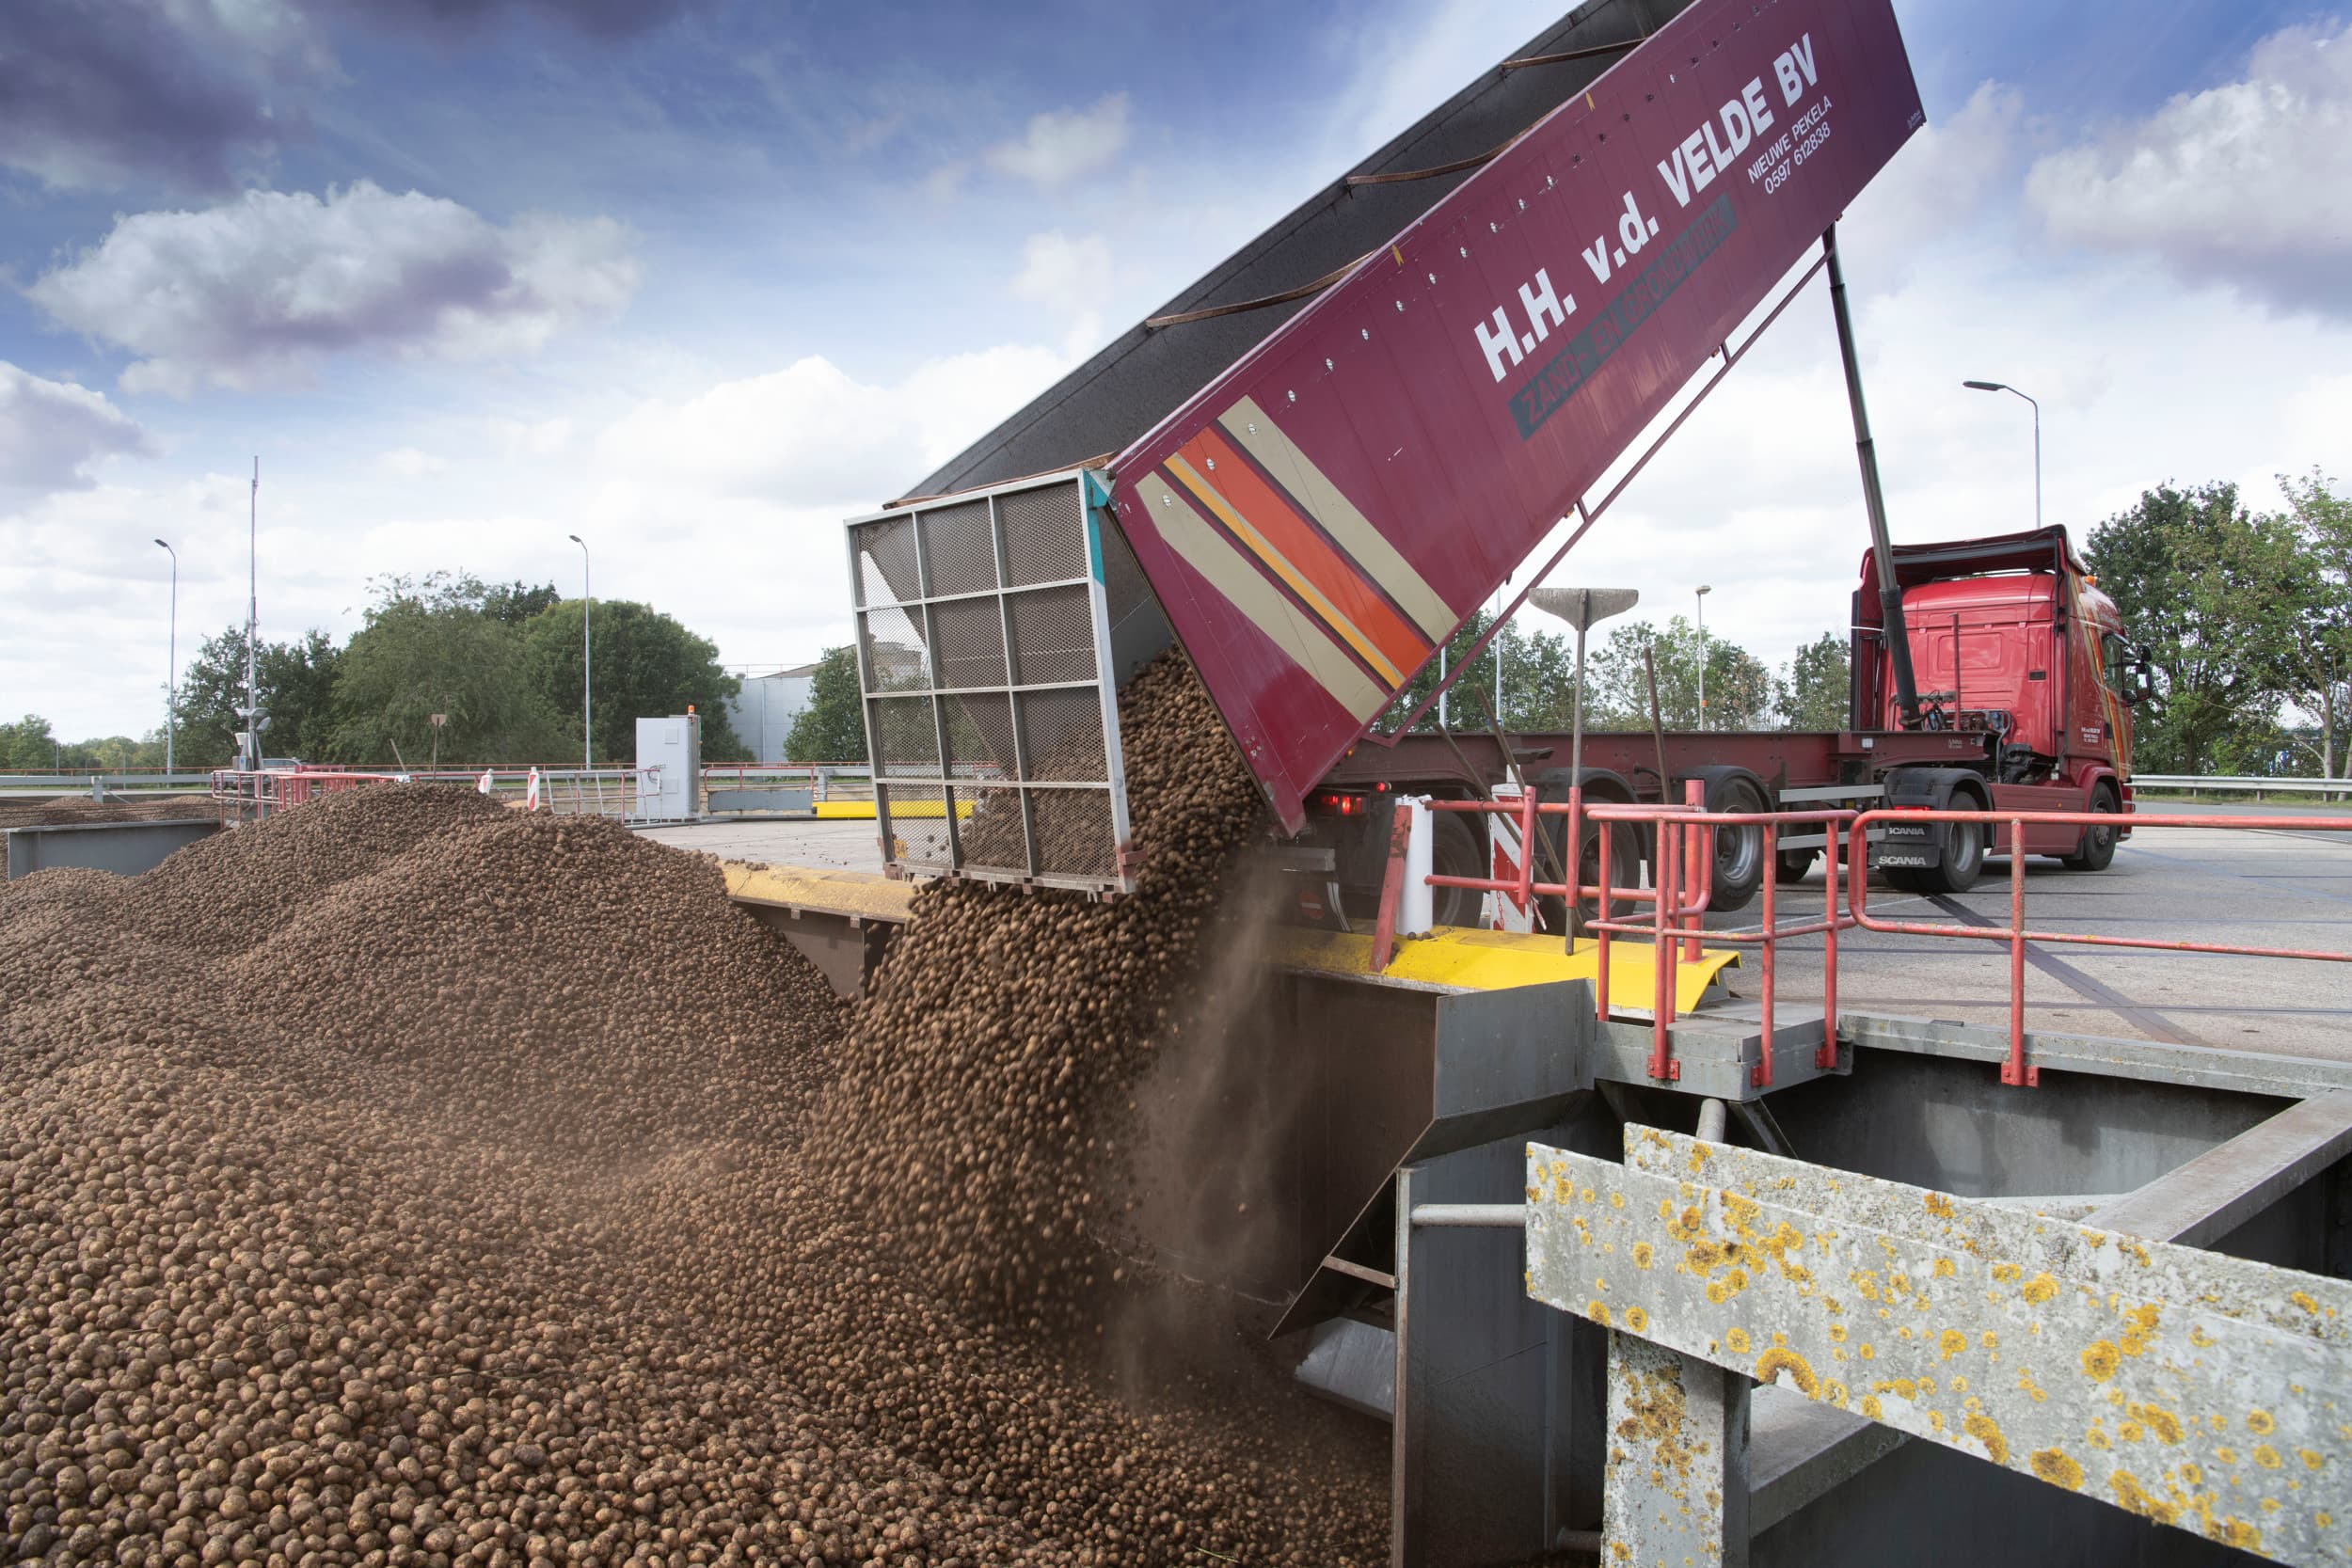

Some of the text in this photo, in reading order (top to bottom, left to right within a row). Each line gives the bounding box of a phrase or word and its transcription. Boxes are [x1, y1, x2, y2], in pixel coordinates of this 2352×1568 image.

[1747, 95, 1833, 184] NIEUWE PEKELA
[1764, 121, 1831, 194] 0597 612838
[1474, 32, 1818, 383] H.H. v.d. VELDE BV
[1591, 310, 1623, 357] EN
[1622, 209, 1729, 325] GRONDWERK
[1878, 855, 1927, 865] SCANIA
